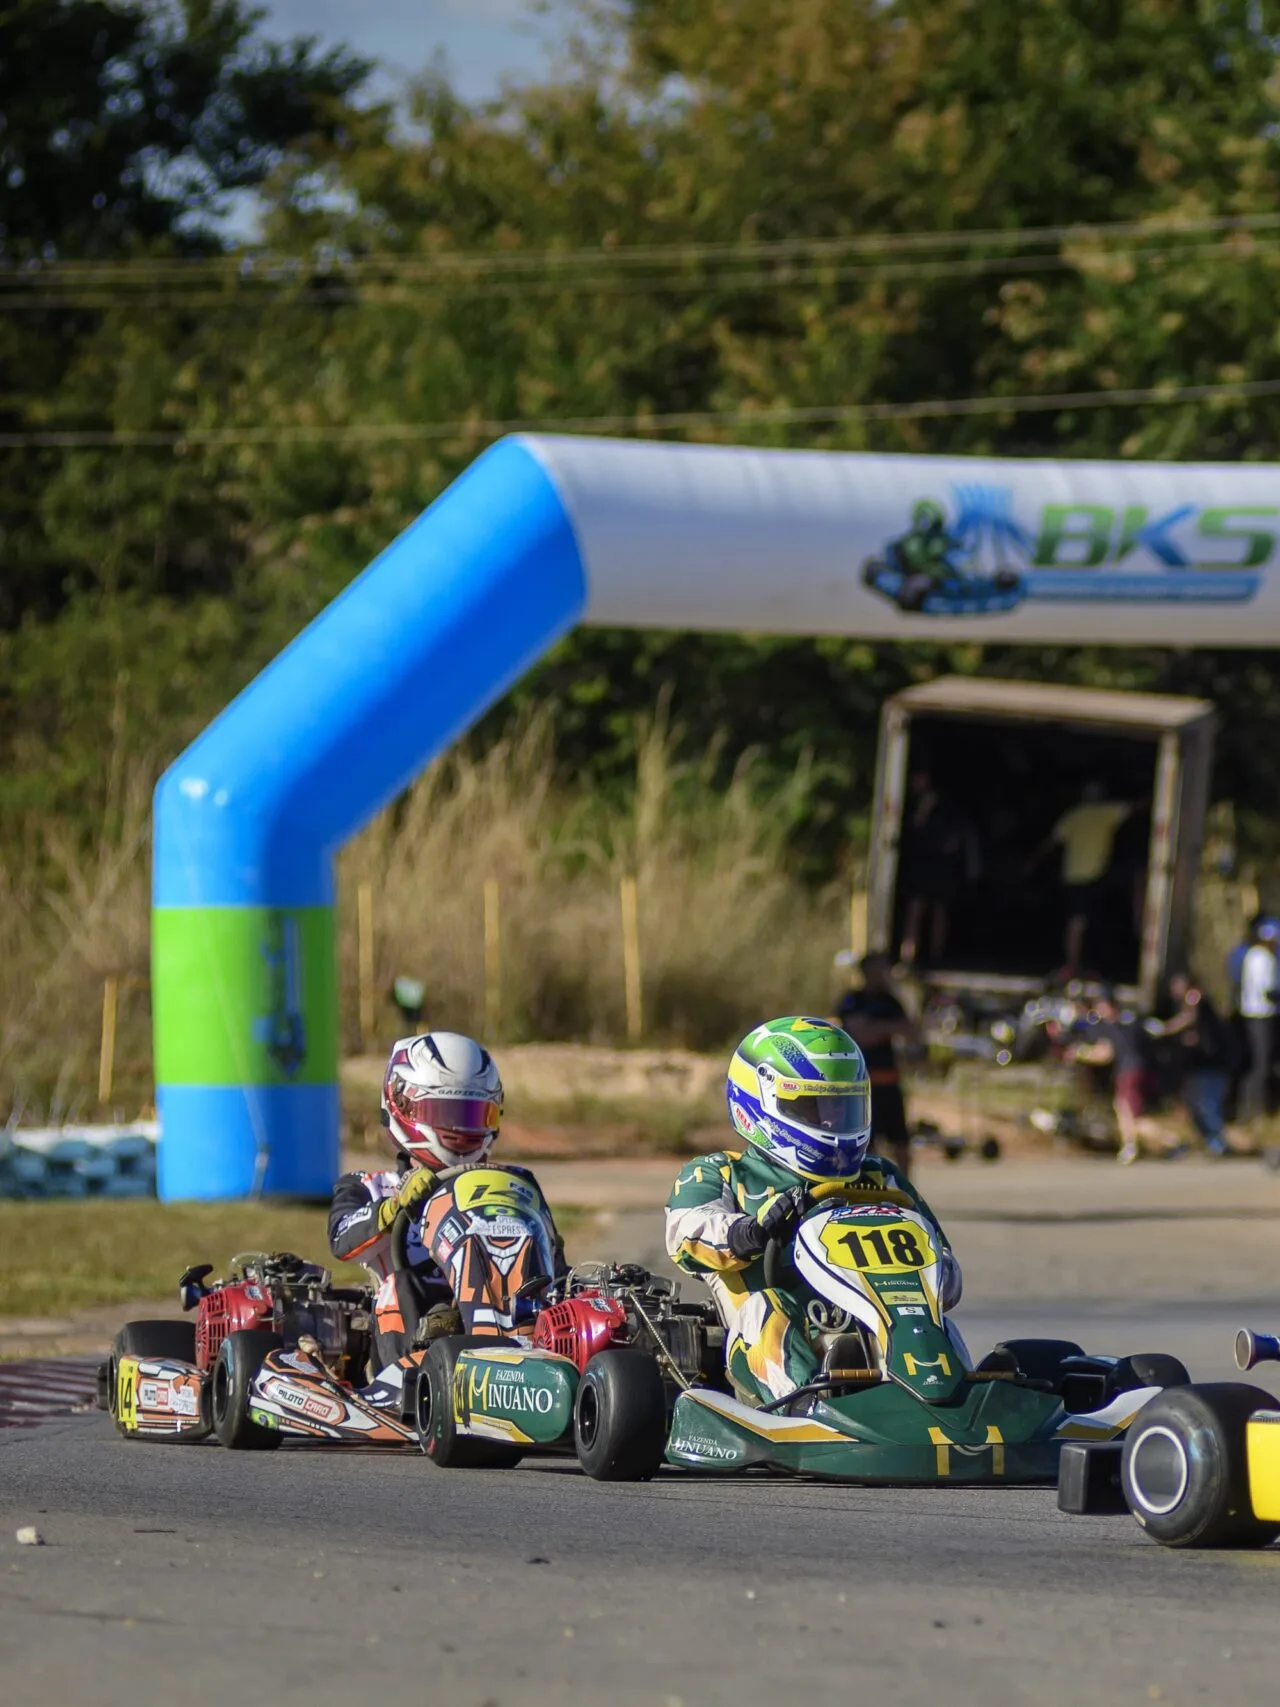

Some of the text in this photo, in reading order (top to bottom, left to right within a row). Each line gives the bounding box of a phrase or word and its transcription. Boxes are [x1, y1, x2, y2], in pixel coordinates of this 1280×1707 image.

[837, 1229, 925, 1268] 118
[495, 1369, 524, 1383] FAZENDA
[278, 1388, 305, 1406] PILOTO
[688, 1434, 718, 1447] FAZENDA
